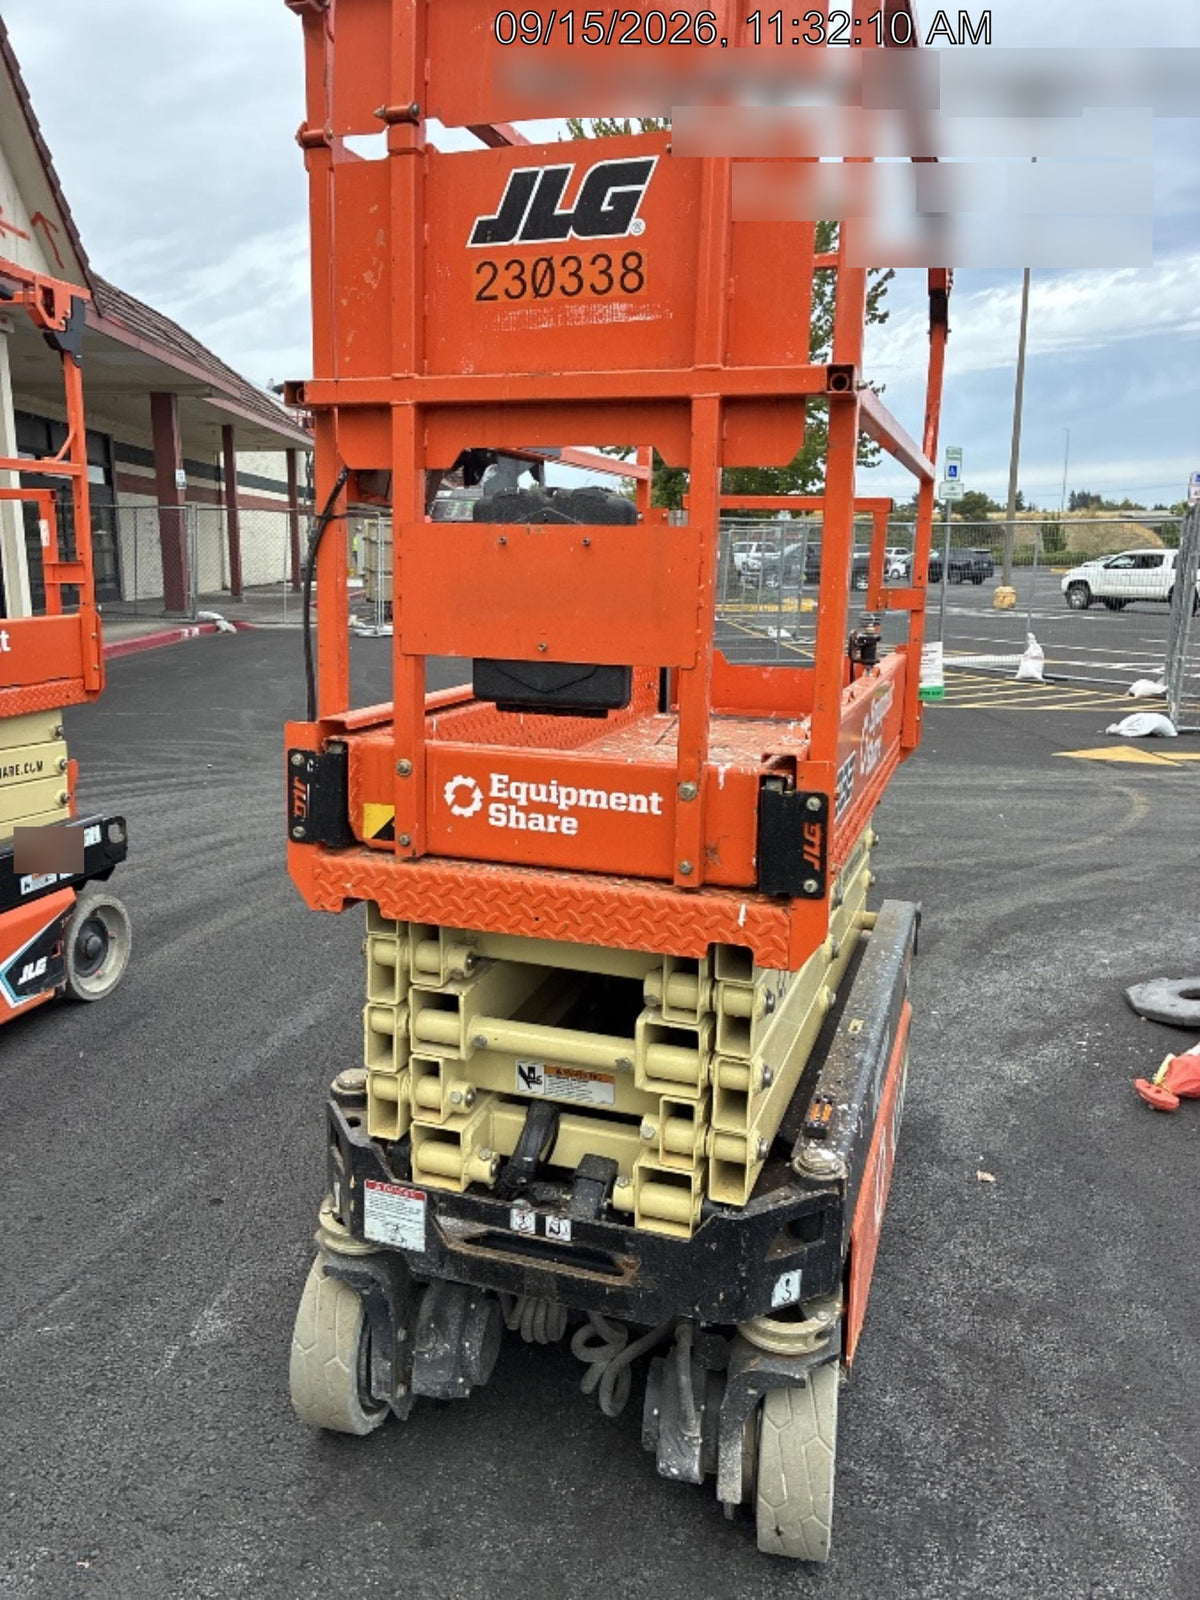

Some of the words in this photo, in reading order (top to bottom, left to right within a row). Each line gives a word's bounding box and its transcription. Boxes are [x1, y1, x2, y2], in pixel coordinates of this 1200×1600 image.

[475, 250, 645, 302] 230338
[293, 776, 307, 819] JLG
[489, 772, 664, 815] Equipment
[488, 802, 579, 836] Share
[803, 821, 822, 872] JLG
[17, 955, 49, 986] JLG
